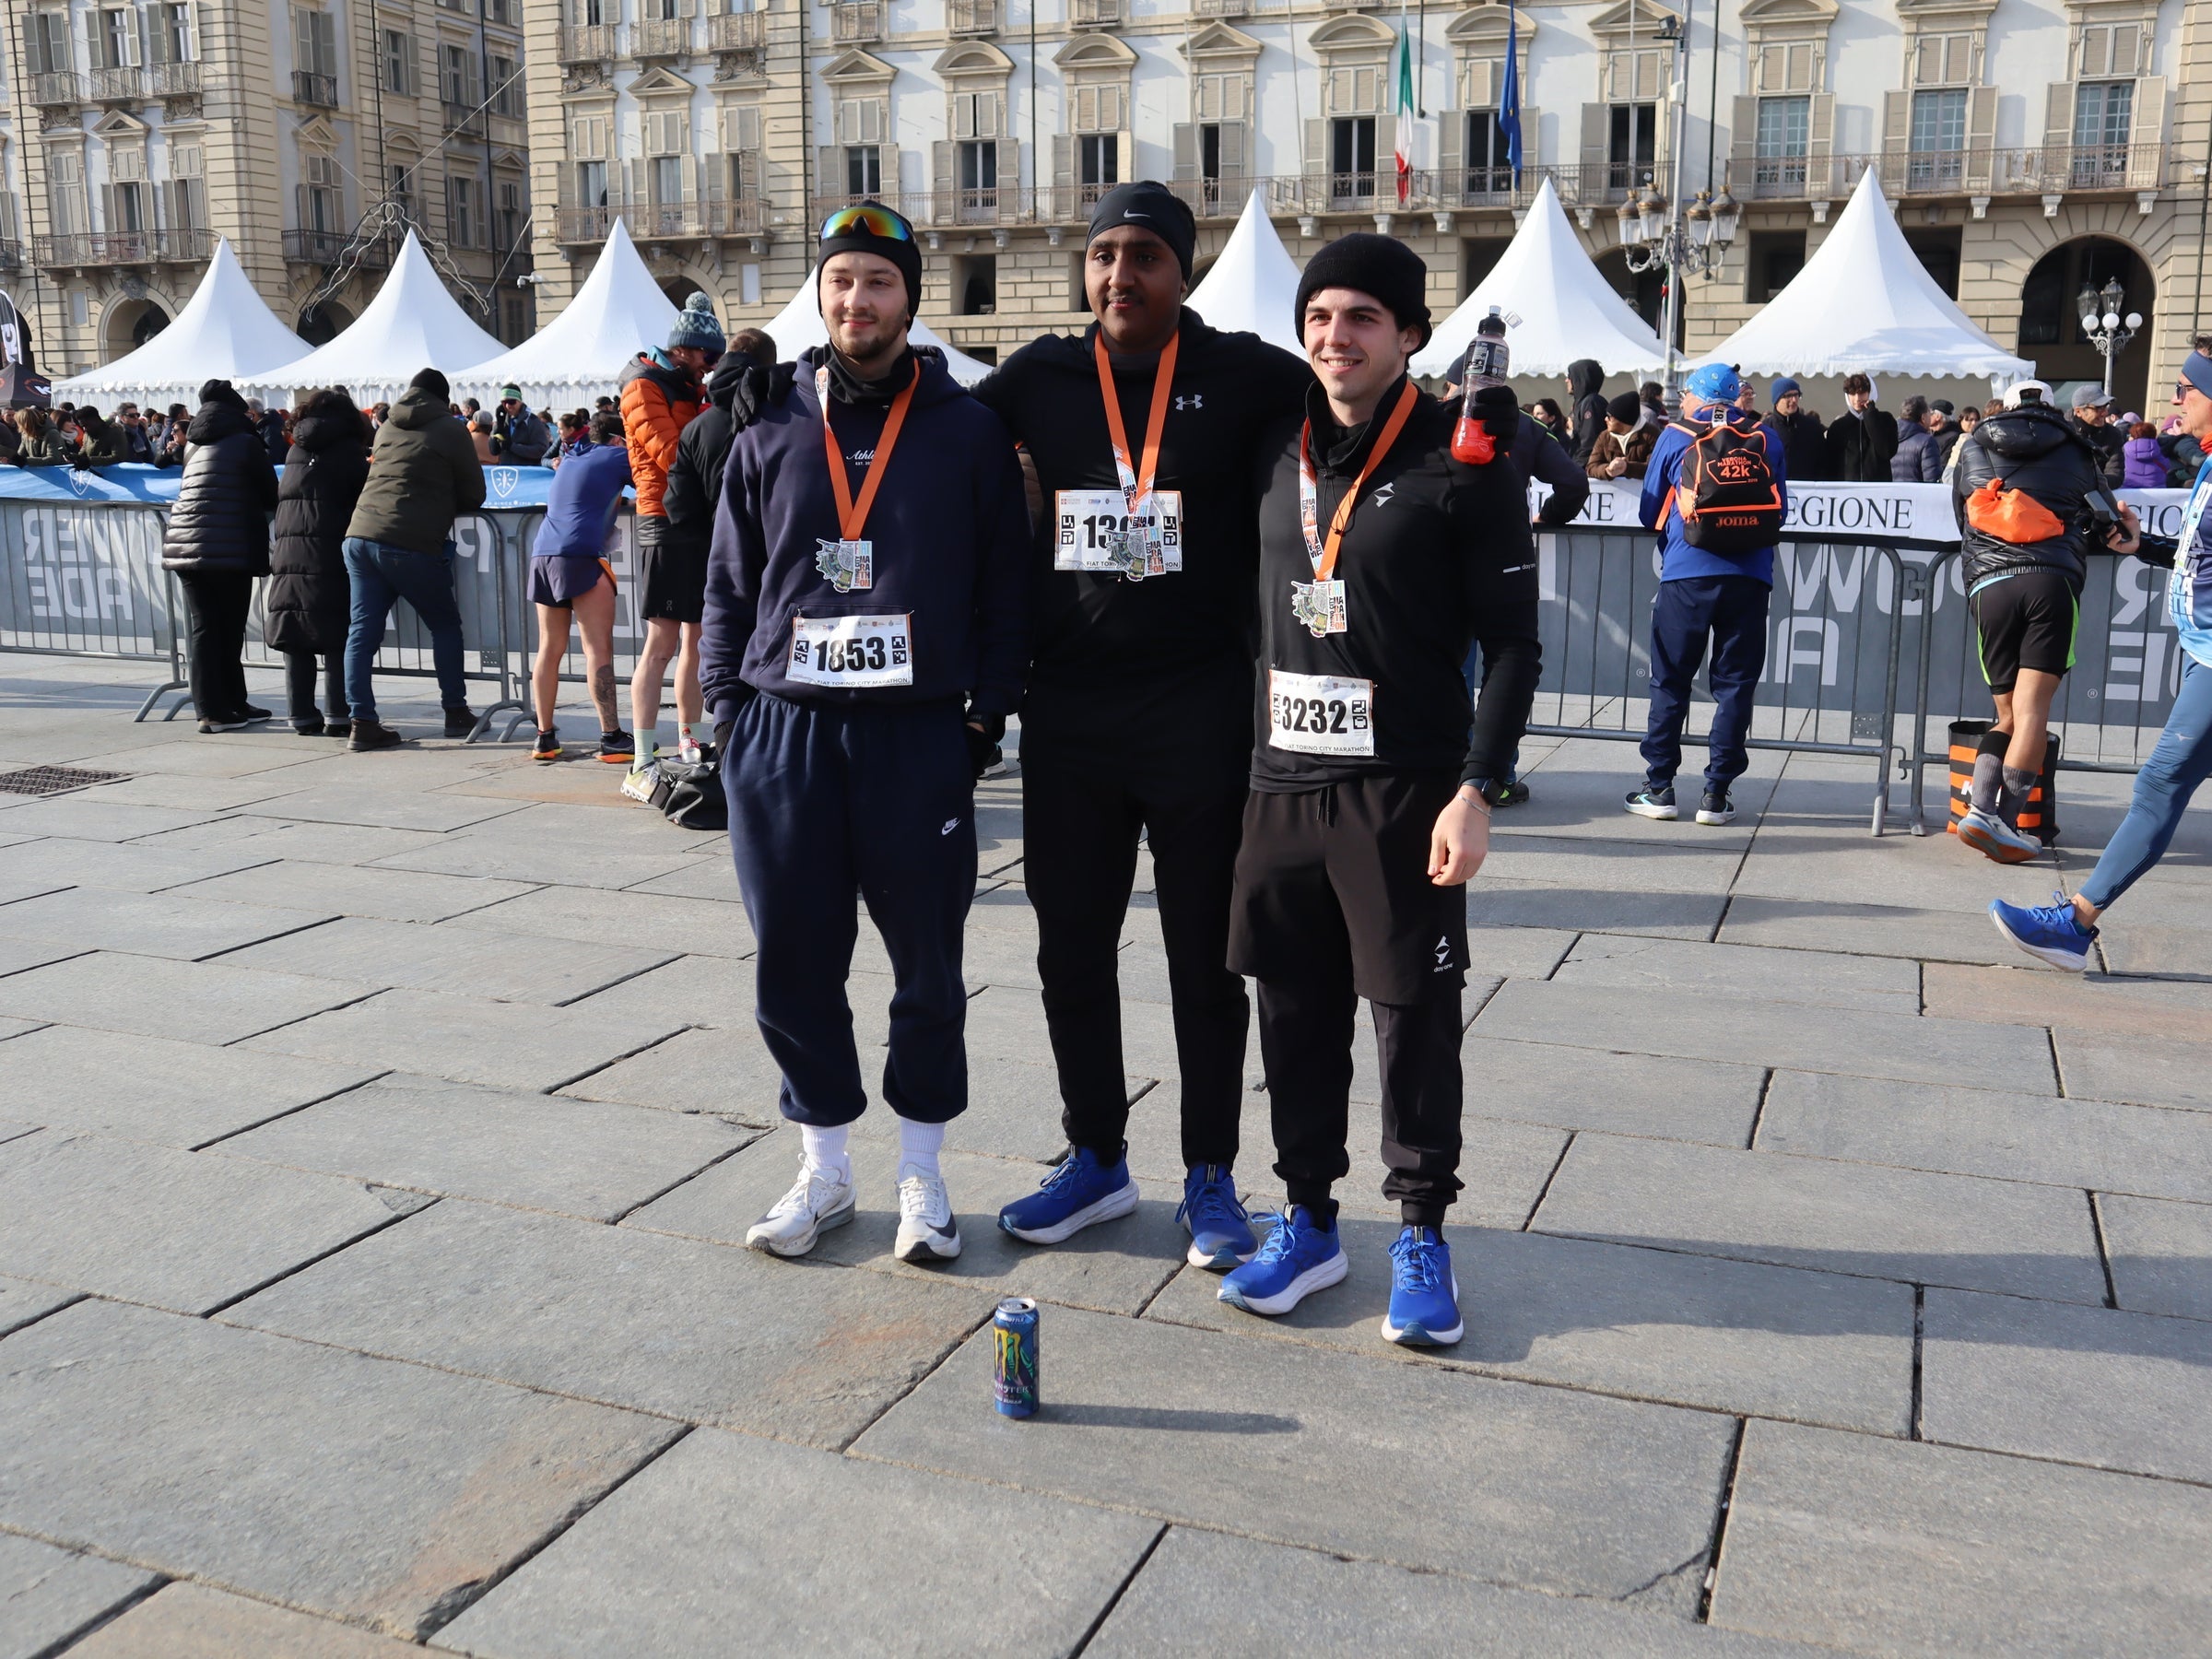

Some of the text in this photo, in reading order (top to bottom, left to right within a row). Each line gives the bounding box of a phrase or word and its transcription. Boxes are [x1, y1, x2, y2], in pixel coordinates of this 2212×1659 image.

[1720, 465, 1750, 477] 42k
[1785, 495, 1912, 529] EGIONE
[1144, 526, 1159, 541] FIAT
[814, 636, 886, 673] 1853
[872, 677, 908, 686] MARATHON
[1282, 696, 1347, 735] 3232
